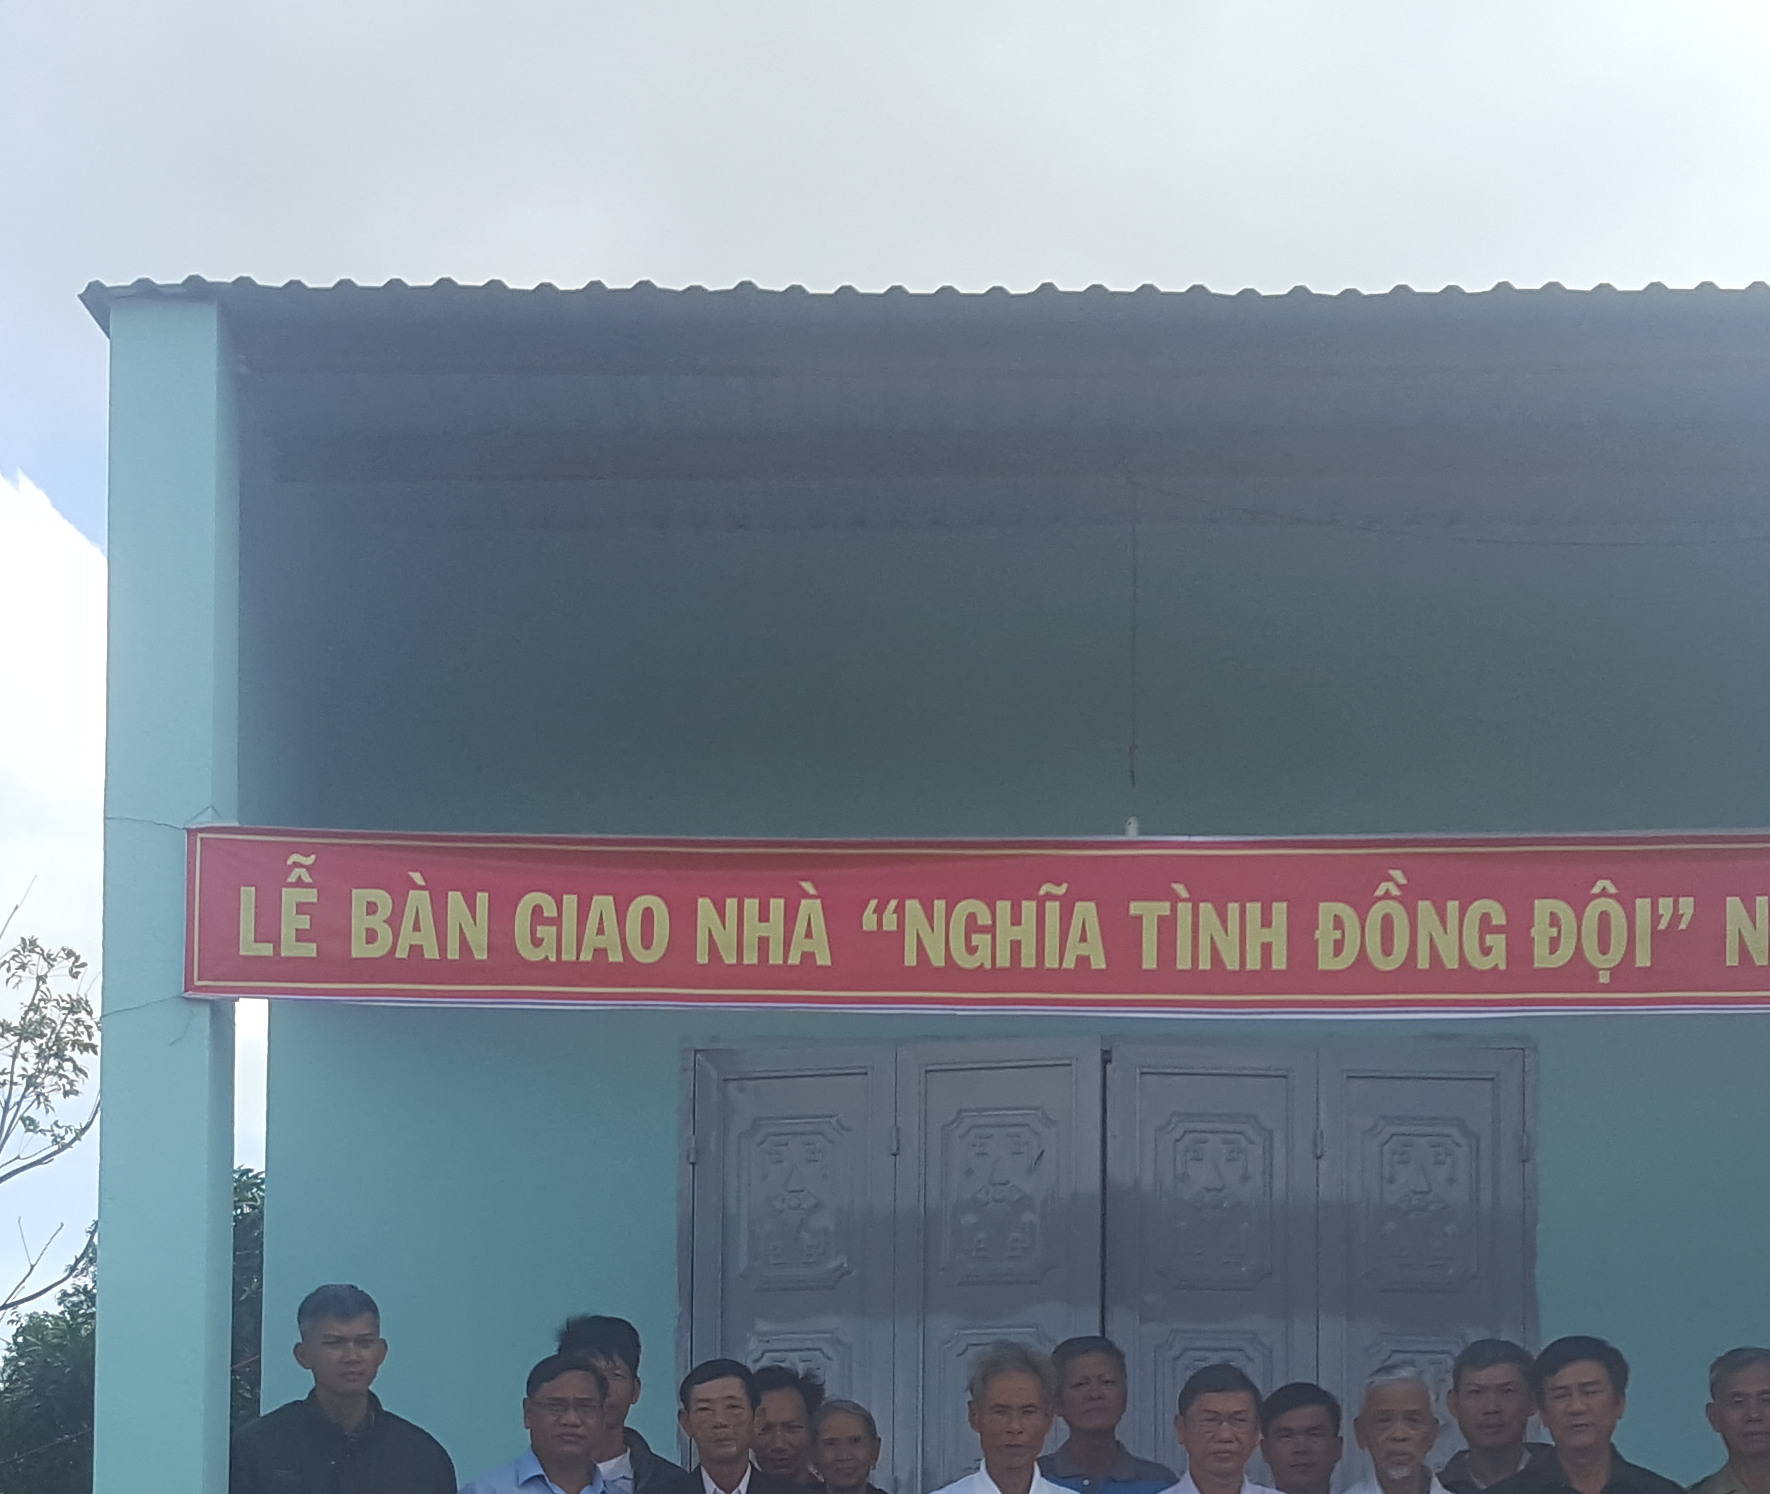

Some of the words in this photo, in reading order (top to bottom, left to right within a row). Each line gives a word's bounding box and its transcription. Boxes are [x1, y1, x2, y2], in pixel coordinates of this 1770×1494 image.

[239, 853, 318, 957] LỄ
[351, 871, 489, 960] BÀN
[514, 892, 670, 963] GIAO
[696, 881, 832, 966] NHÀ
[861, 882, 1107, 970] “NGHĨA
[1129, 882, 1287, 970] TÌNH
[1315, 869, 1508, 971] ĐỒNG
[1531, 879, 1695, 984] ĐỘI”
